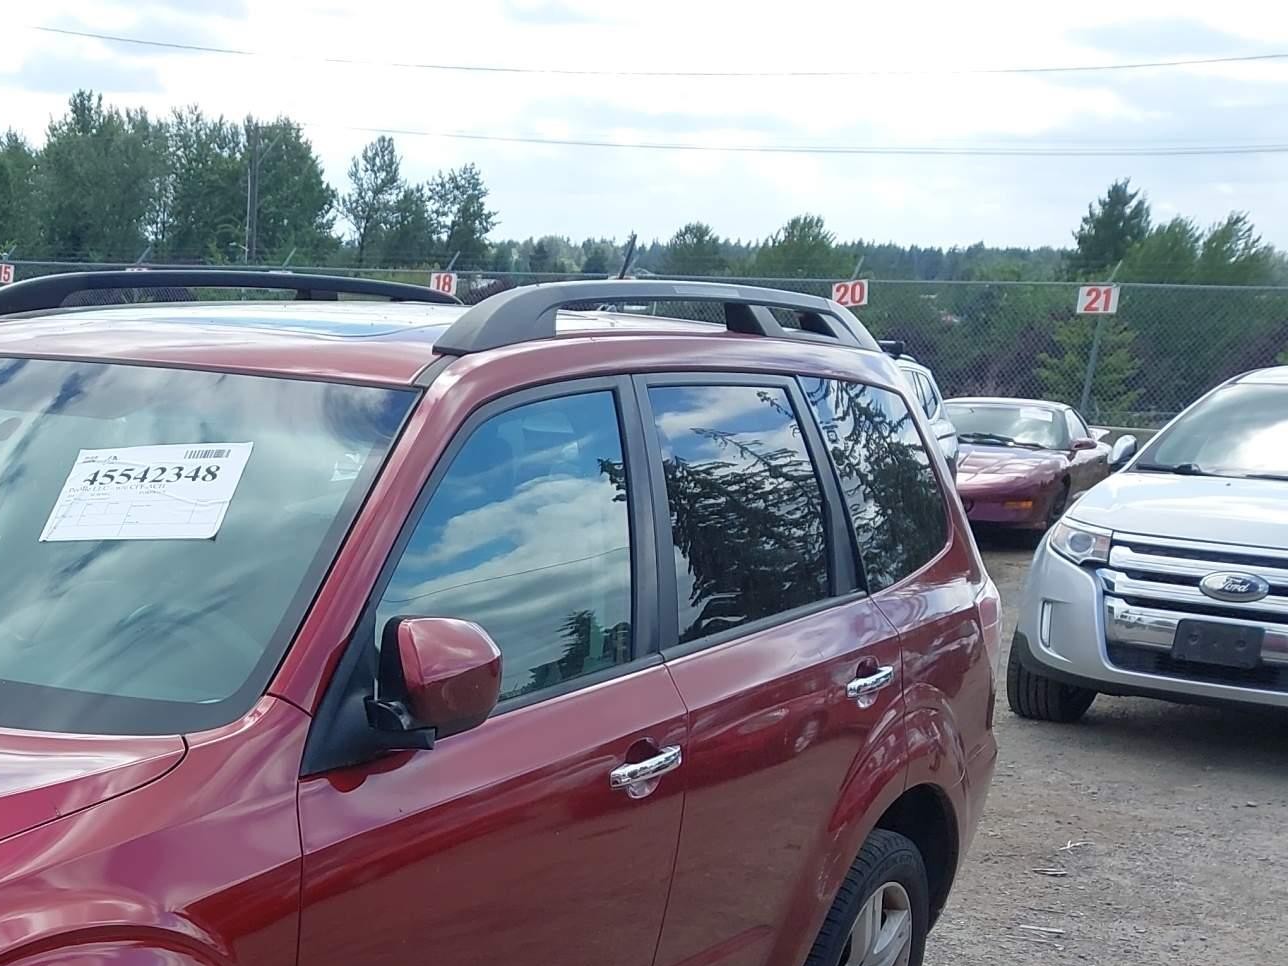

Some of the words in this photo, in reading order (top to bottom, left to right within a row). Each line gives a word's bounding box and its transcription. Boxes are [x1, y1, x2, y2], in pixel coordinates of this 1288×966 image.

[435, 274, 453, 292] 18
[835, 282, 865, 306] 20
[1083, 288, 1113, 312] 21
[82, 465, 221, 486] 45542348
